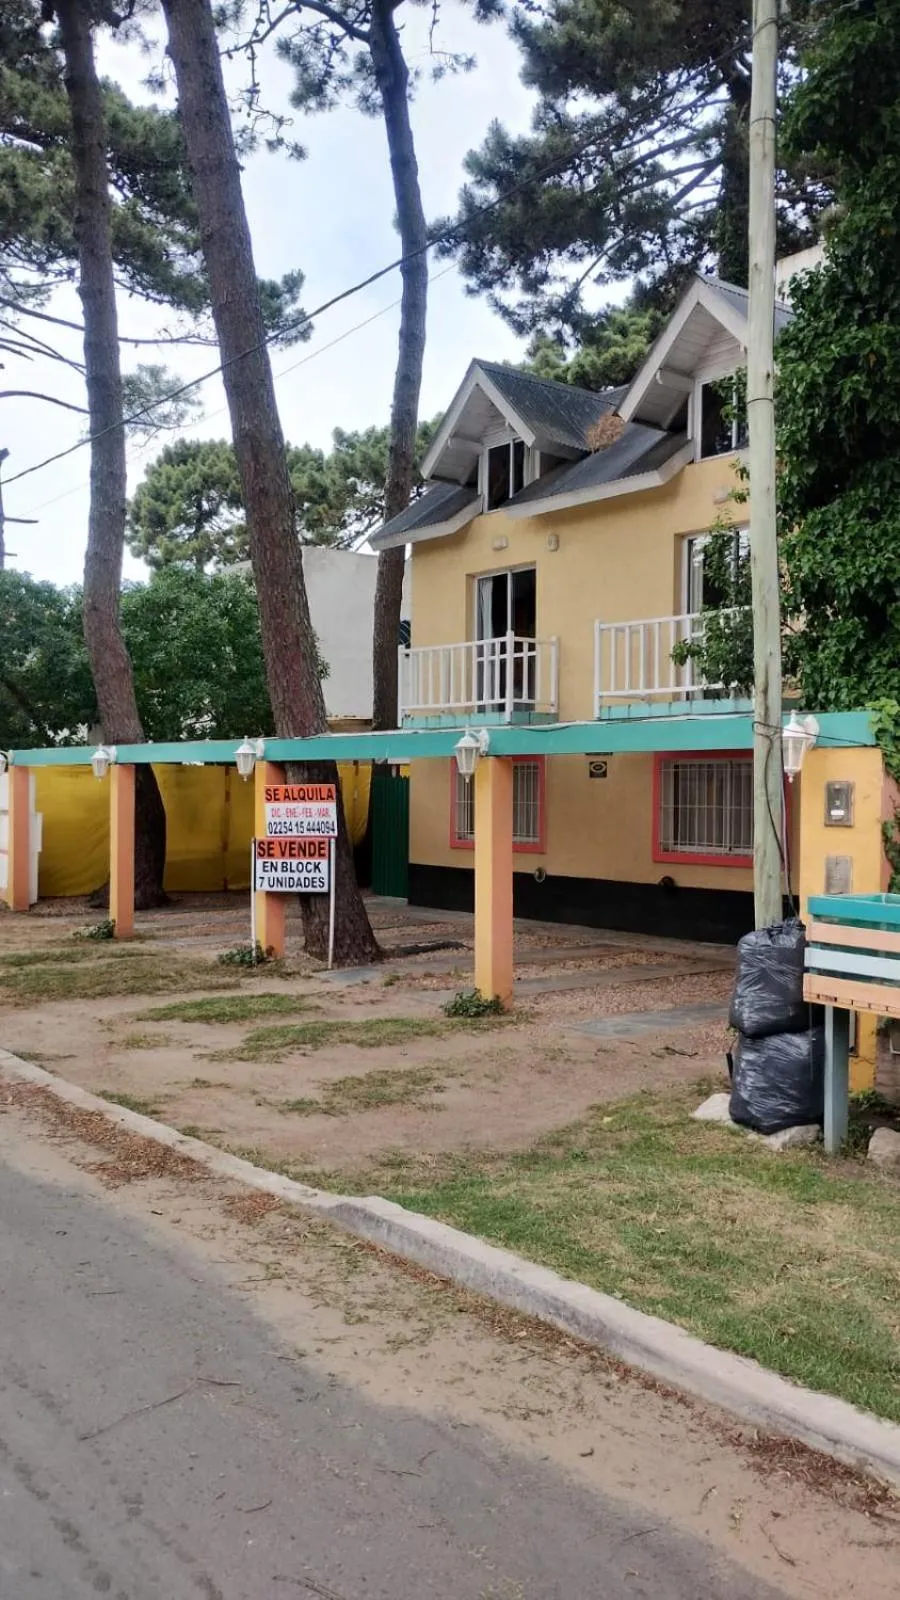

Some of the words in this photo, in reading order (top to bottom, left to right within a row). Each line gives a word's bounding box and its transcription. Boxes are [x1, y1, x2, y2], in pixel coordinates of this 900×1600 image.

[265, 788, 280, 801] SE
[284, 787, 334, 802] ALQUILA
[258, 841, 275, 857] SE
[279, 841, 326, 857] VENDE
[262, 861, 278, 873] EN
[281, 861, 322, 873] BLOCK
[259, 876, 265, 888] 7
[268, 876, 325, 888] UNIDADES
